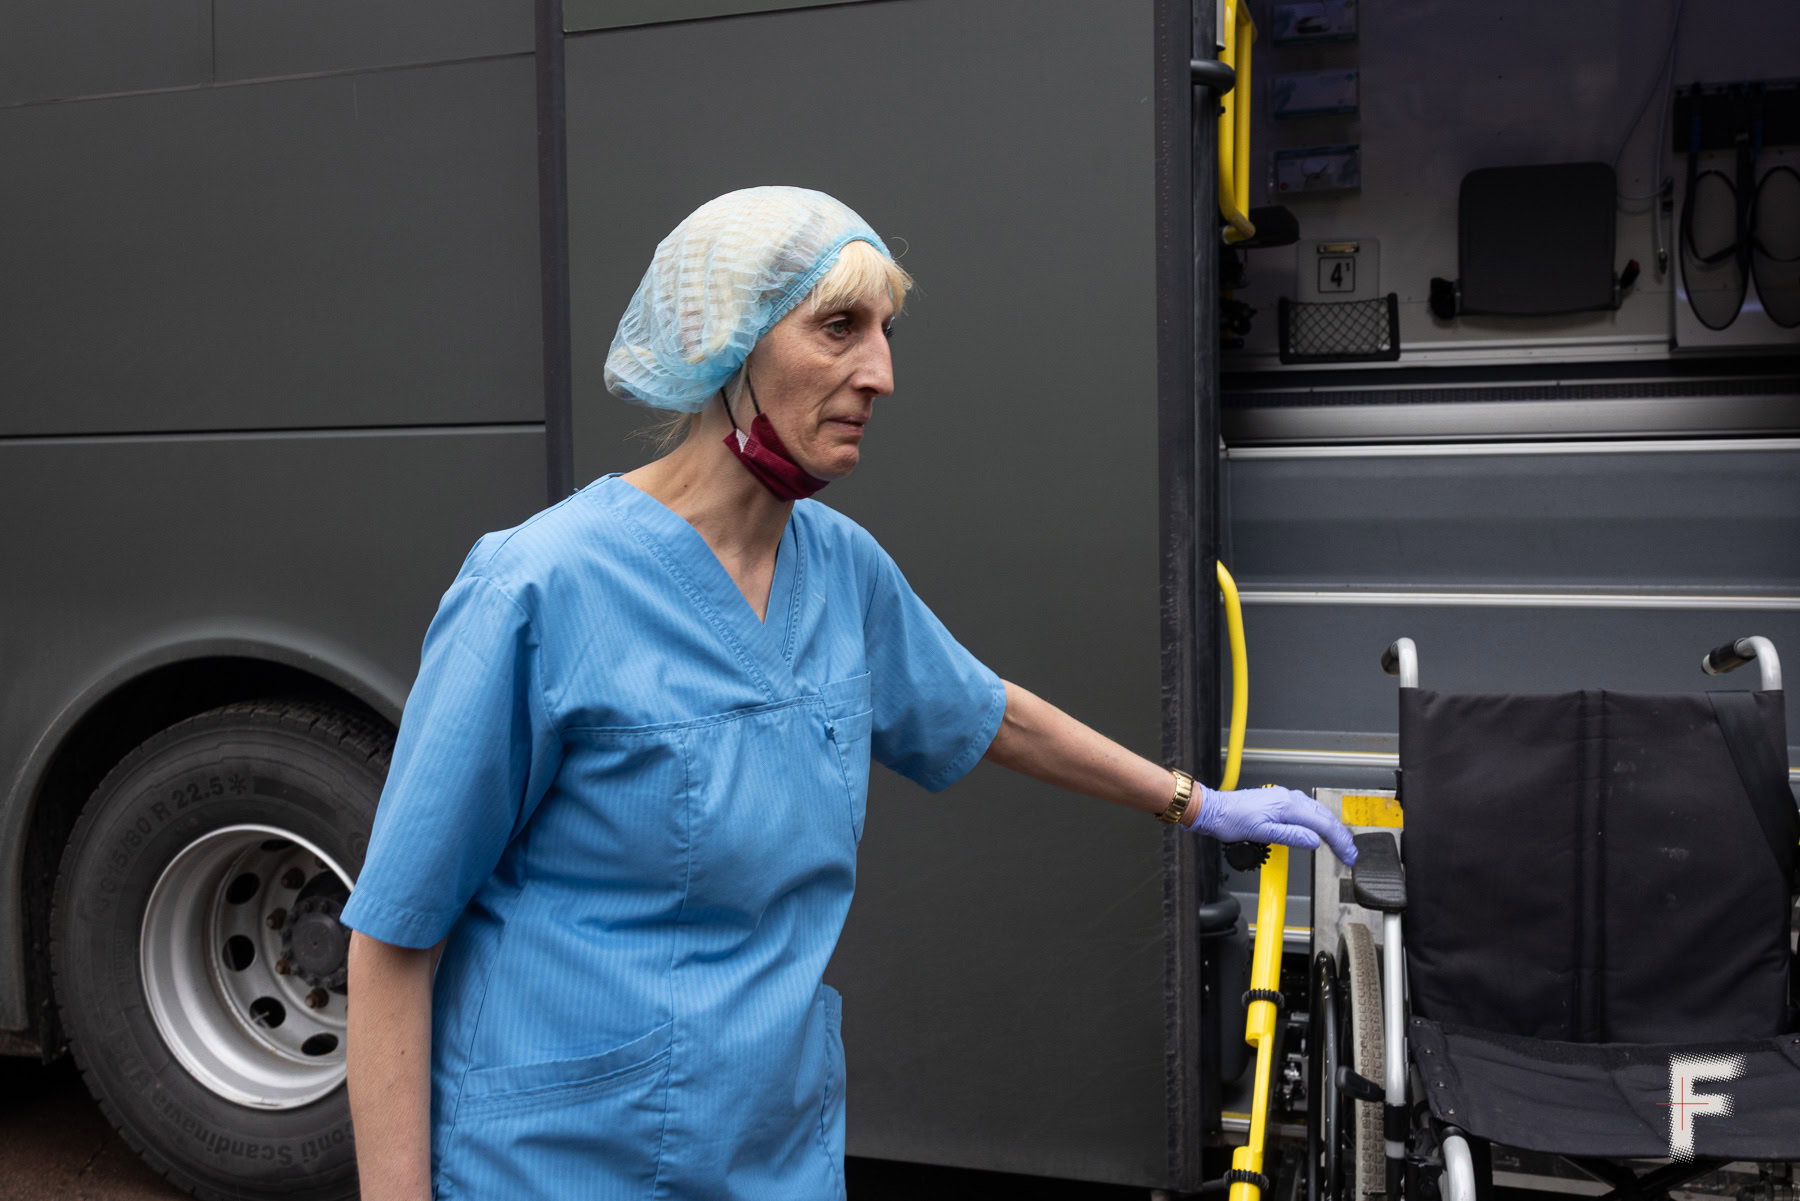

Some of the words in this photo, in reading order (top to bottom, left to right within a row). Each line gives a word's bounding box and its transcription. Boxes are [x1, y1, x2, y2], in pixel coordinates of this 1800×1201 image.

[151, 801, 172, 822] R
[172, 776, 224, 809] 22.5
[151, 1089, 292, 1165] Scandinavia
